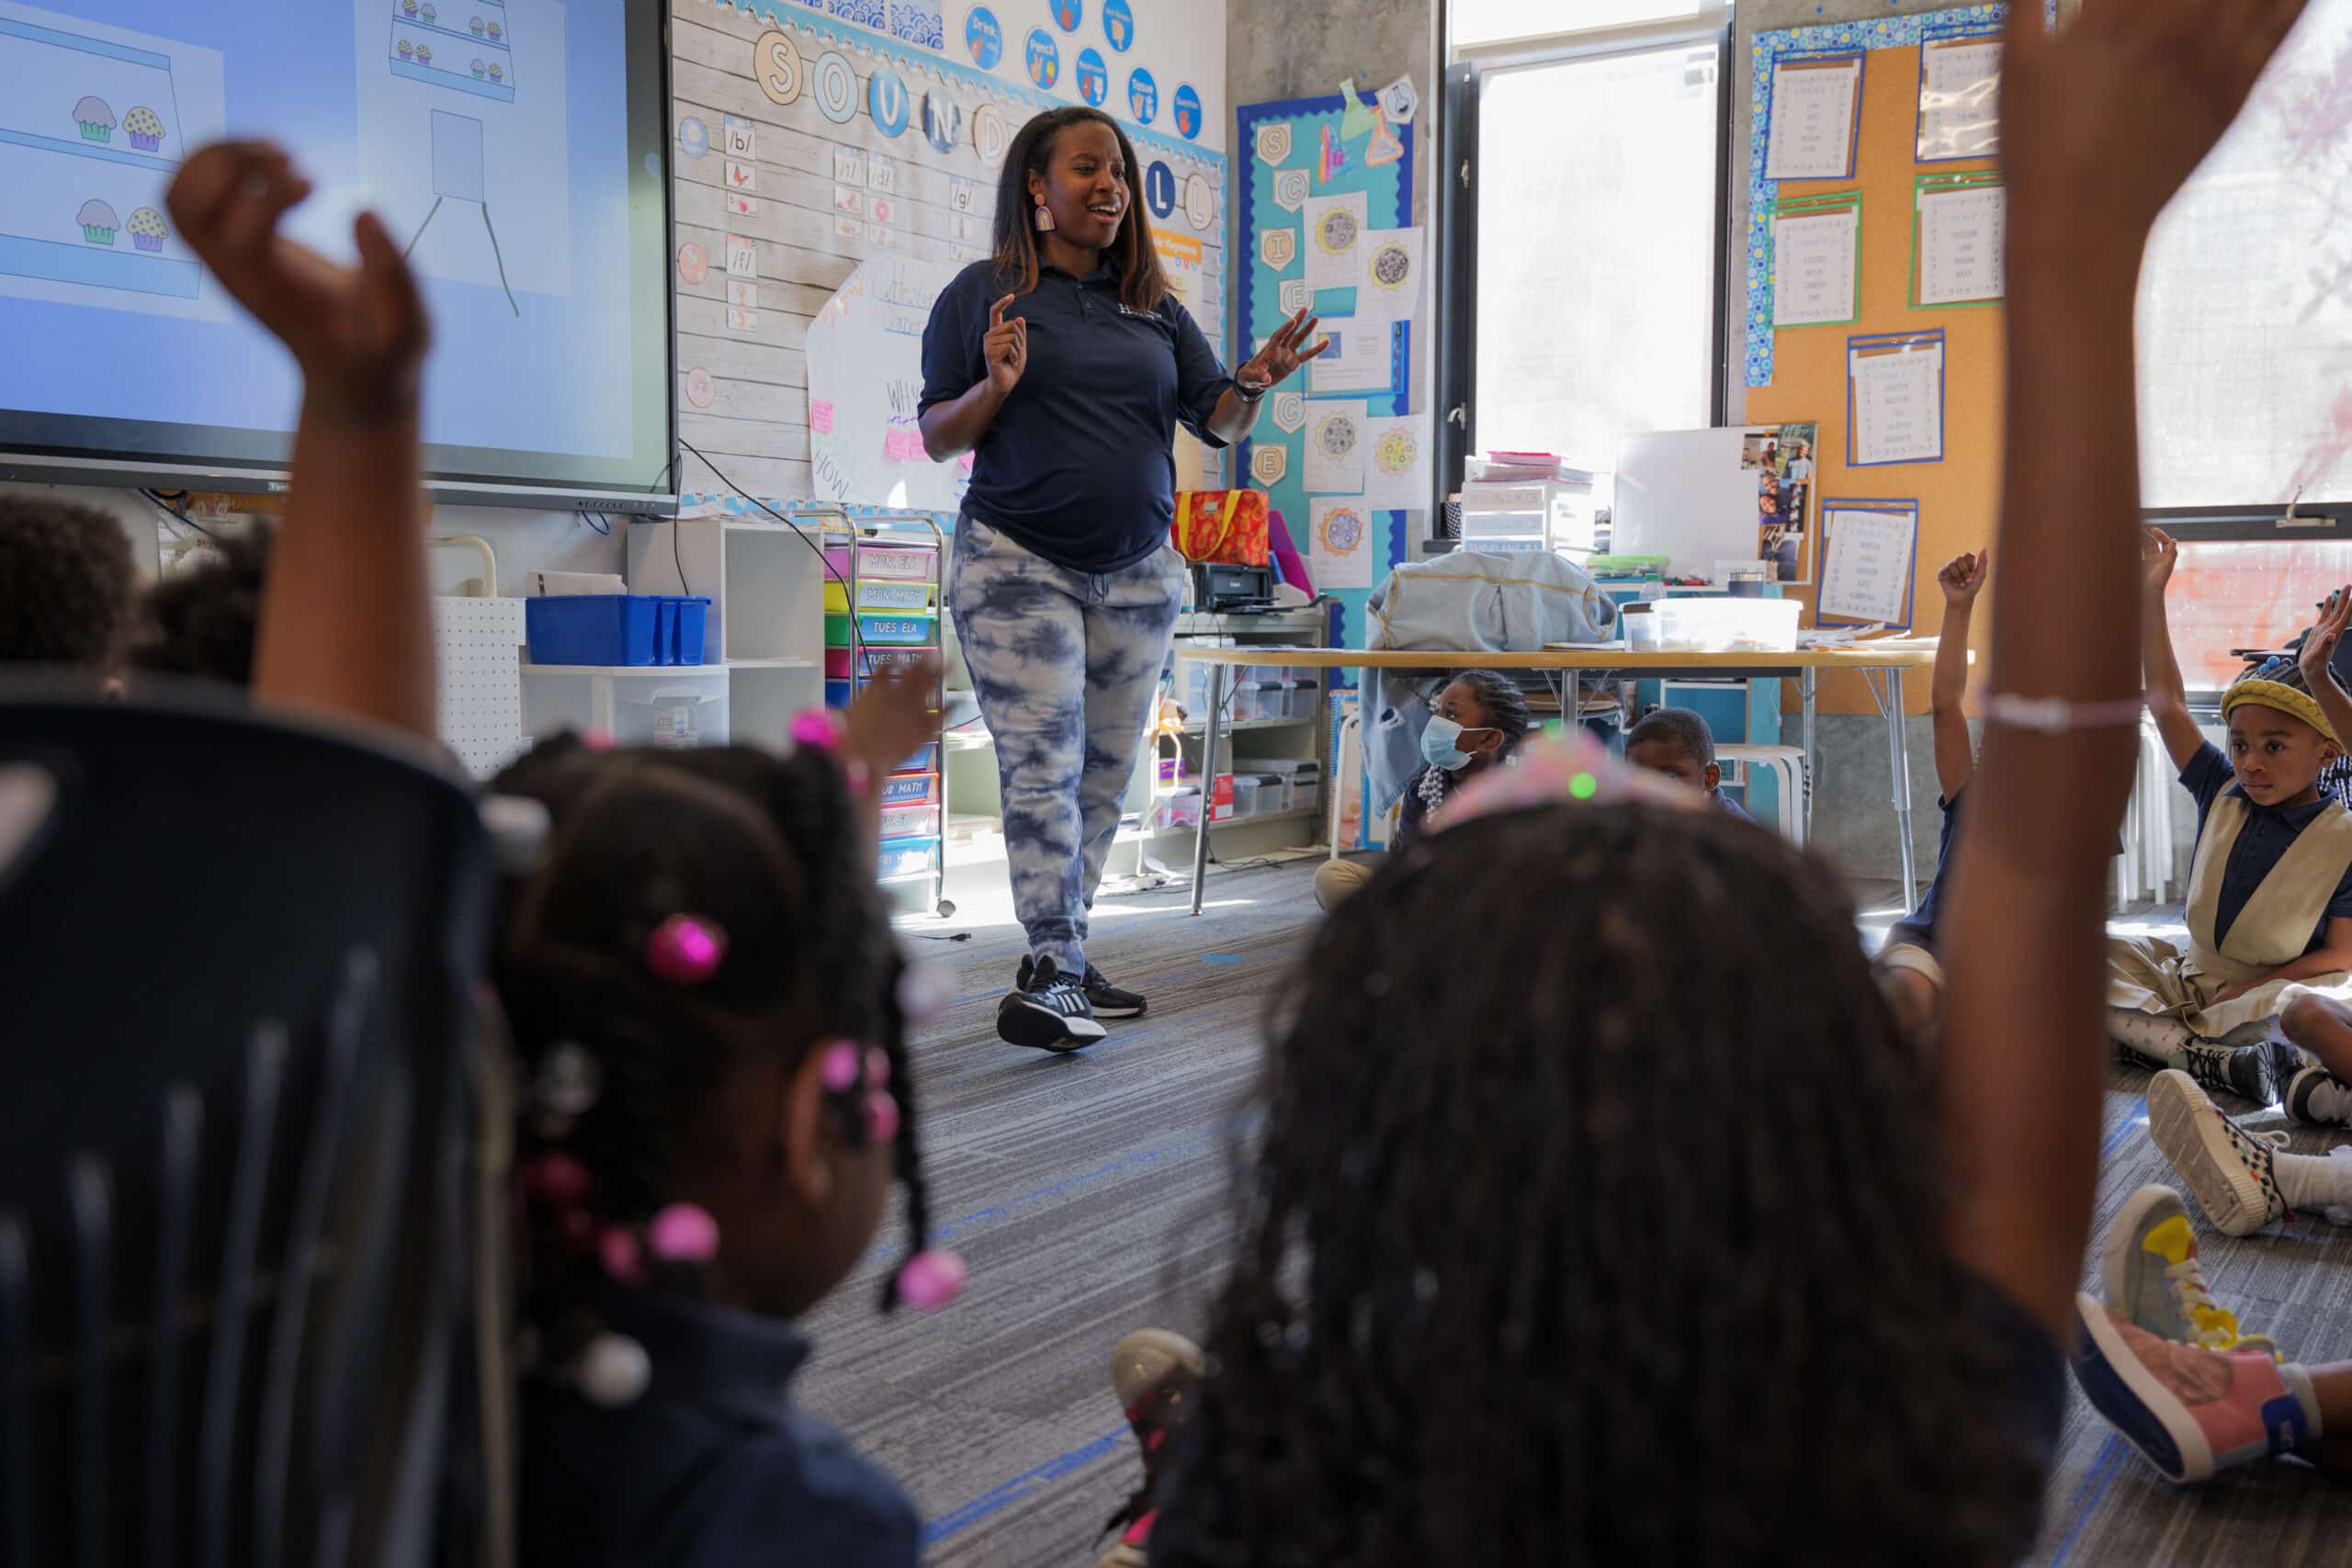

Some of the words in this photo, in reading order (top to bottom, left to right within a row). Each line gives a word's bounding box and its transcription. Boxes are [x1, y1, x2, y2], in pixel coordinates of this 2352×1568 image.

[1030, 38, 1055, 56] Pencil
[770, 41, 1003, 163] SOUND
[1155, 170, 1205, 222] LL
[887, 378, 920, 413] WHY
[813, 447, 850, 499] HOW
[898, 556, 918, 570] ELA
[874, 622, 897, 633] TUES
[902, 622, 918, 633] ELA
[867, 654, 891, 665] TUES
[899, 782, 923, 795] MATH
